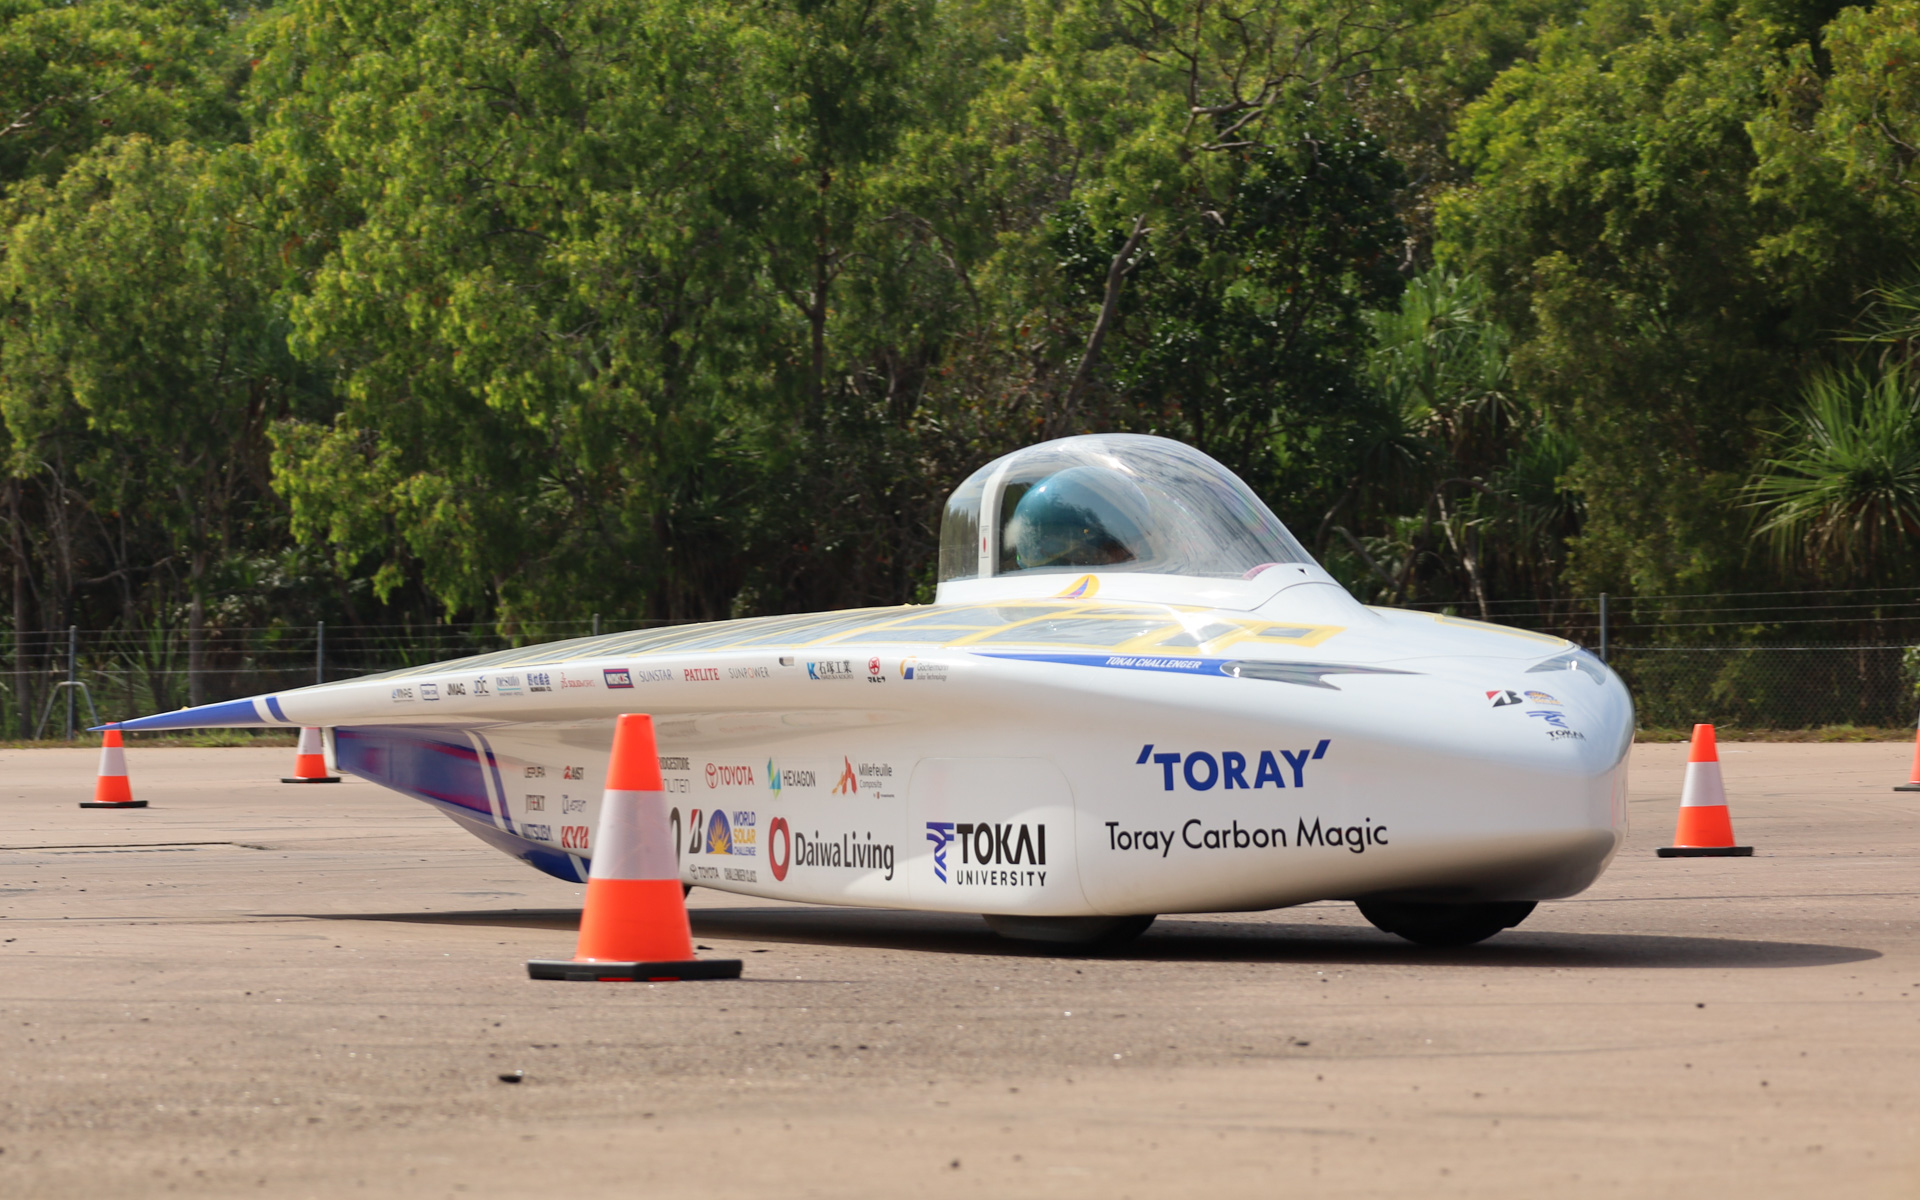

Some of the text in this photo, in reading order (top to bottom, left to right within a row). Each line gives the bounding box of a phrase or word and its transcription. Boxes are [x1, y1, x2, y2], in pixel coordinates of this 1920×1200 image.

[1105, 656, 1203, 669] TOKAI CHALLENGER
[639, 669, 674, 682] SUNSTAR
[684, 668, 720, 682] PATLITE
[728, 666, 770, 679] SUNPOWER
[718, 766, 755, 785] TOYOTA
[782, 770, 816, 787] HEXAGON
[733, 811, 756, 826] WORLD
[561, 825, 589, 848] KYB
[733, 828, 756, 844] SOLAR
[956, 822, 1046, 865] TOKAI
[1105, 816, 1389, 858] Toray Carbon Magic
[734, 846, 756, 856] CHALLENGE
[698, 866, 719, 879] TOYOTA
[957, 870, 1047, 886] UNIVERSITY
